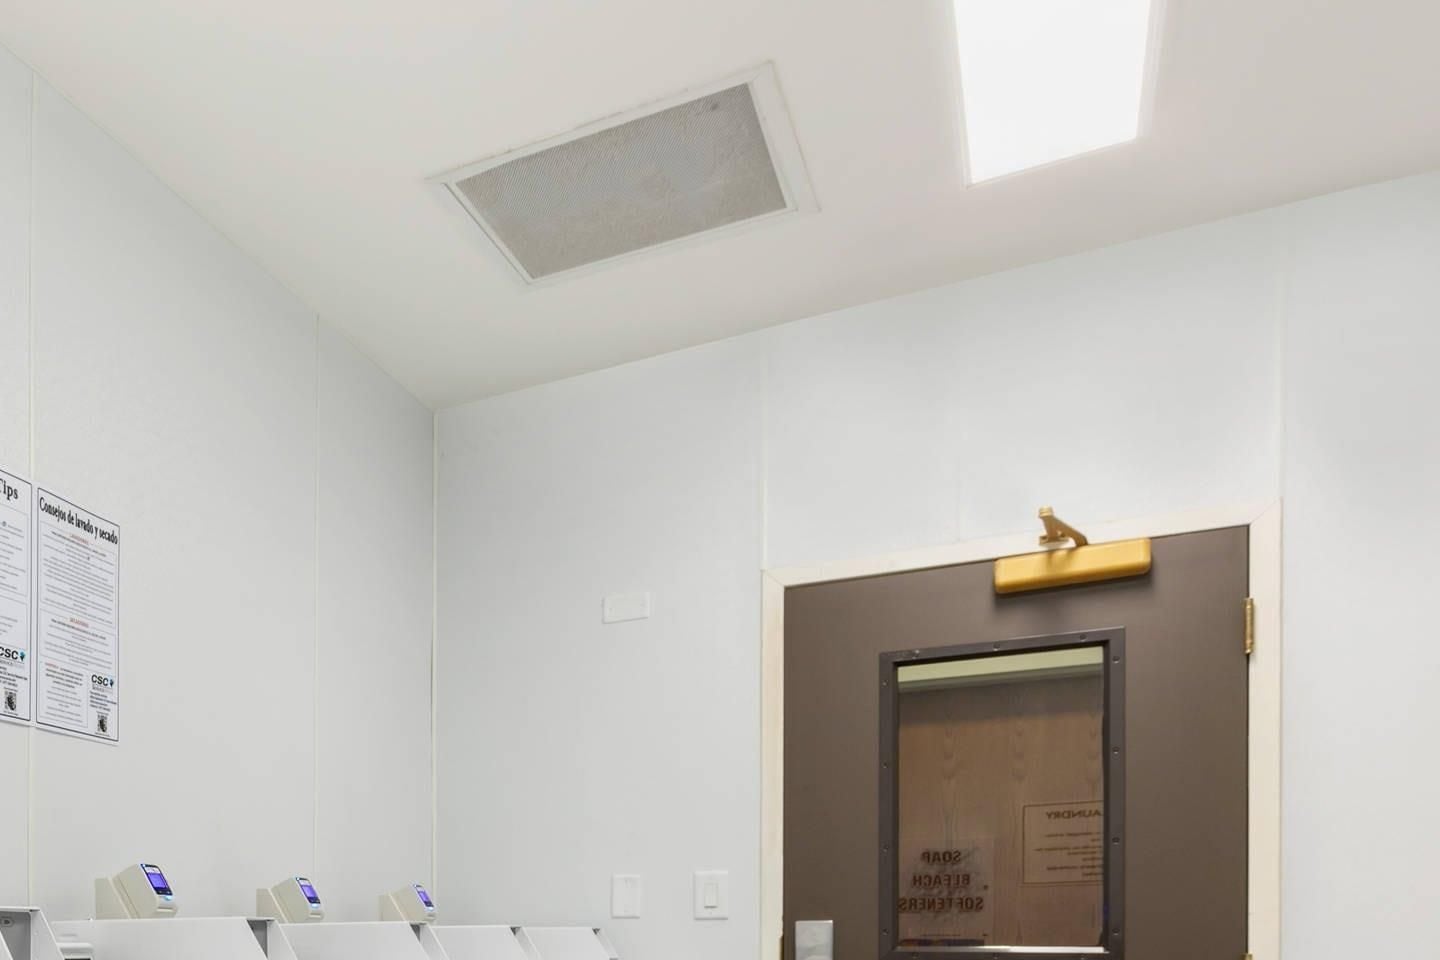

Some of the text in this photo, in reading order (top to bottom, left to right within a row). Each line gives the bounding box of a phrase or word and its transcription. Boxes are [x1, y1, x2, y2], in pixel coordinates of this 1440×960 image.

[39, 496, 66, 522] Consejos
[67, 509, 74, 526] de
[75, 512, 93, 535] lavado
[99, 528, 118, 545] secado
[91, 674, 109, 687] CSC
